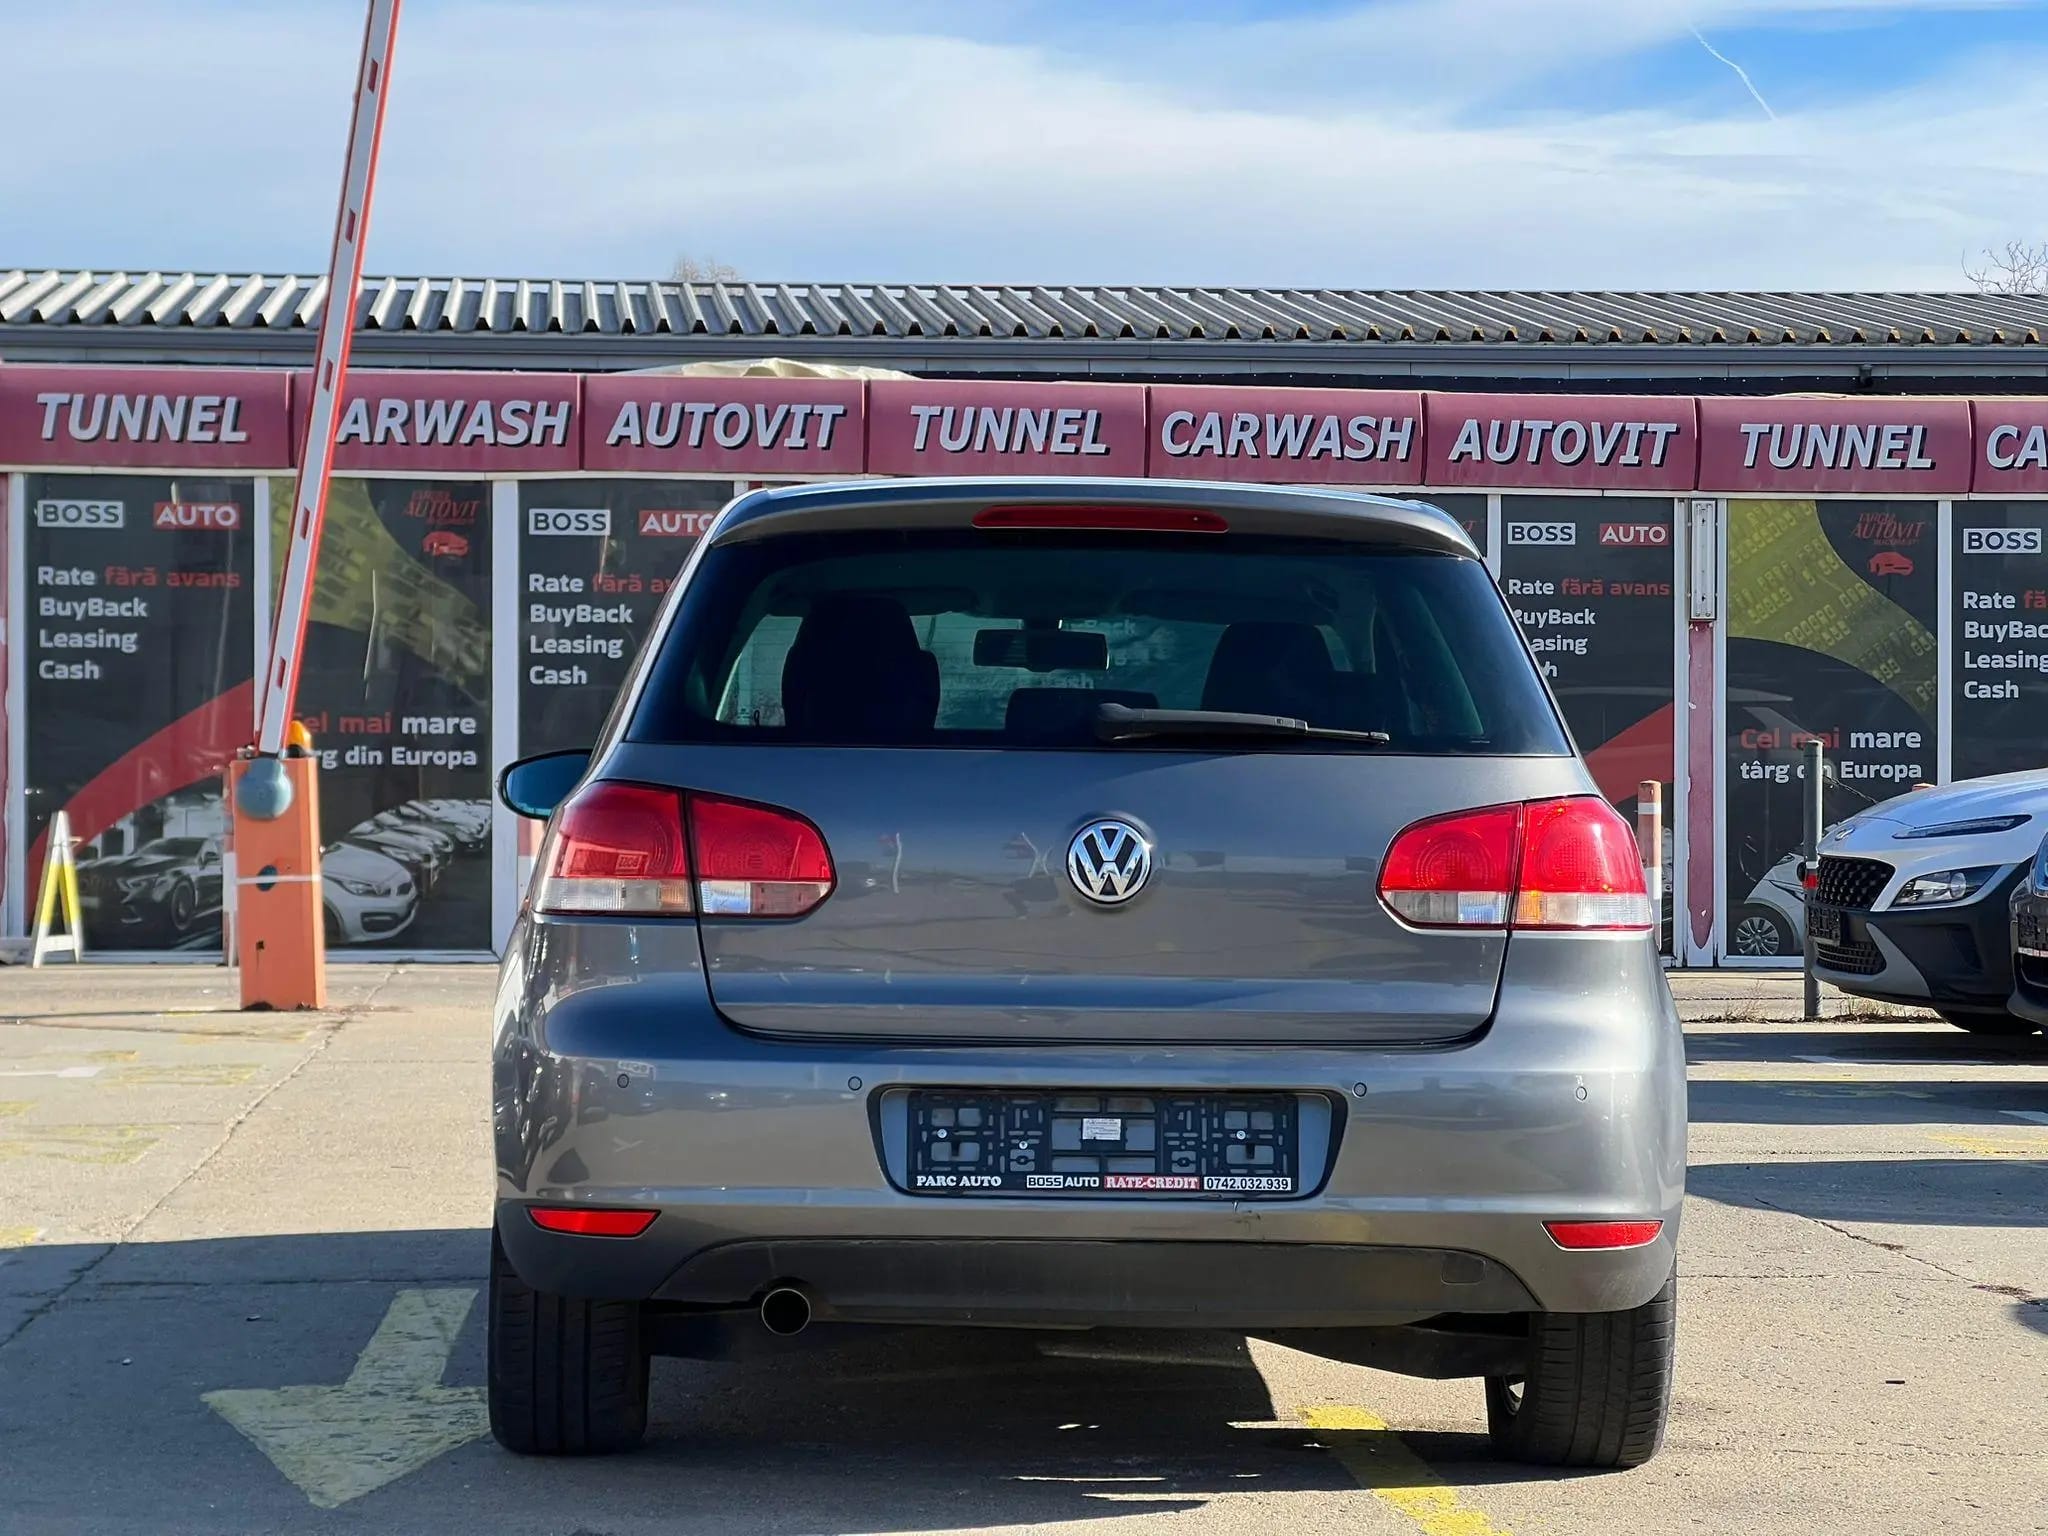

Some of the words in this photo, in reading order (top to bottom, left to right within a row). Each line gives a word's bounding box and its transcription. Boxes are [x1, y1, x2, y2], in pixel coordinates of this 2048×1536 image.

[37, 393, 249, 443] TUNNEL
[335, 398, 571, 446] ARWASH
[606, 401, 846, 449] AUTOVIT
[910, 405, 1109, 454] TUNNEL
[1161, 410, 1415, 460] CARWASH
[1448, 419, 1679, 467] AUTOVIT
[1739, 423, 1935, 469] TUNNEL
[1986, 424, 2048, 470] CA
[42, 504, 120, 523] BOSS
[156, 505, 238, 527] AUTO
[533, 512, 607, 531] BOSS
[1511, 525, 1573, 542] BOSS
[1601, 526, 1666, 543] AUTO
[1967, 531, 2038, 550] BOSS
[37, 566, 96, 586] Rate
[166, 572, 240, 587] avans
[528, 573, 584, 593] Rate
[1508, 578, 1555, 595] Rate
[1609, 583, 1670, 595] avans
[39, 597, 149, 621] BuyBack
[1963, 591, 2016, 609] Rate
[2024, 590, 2048, 609] fă
[530, 603, 633, 627] BuyBack
[39, 628, 139, 653] Leasing
[1964, 620, 2048, 643] BuyBac
[529, 634, 624, 659] Leasing
[1530, 634, 1588, 655] asing
[38, 660, 101, 680] Cash
[529, 664, 588, 685] Cash
[1964, 680, 2019, 699] Cash
[339, 711, 392, 734] mai
[401, 716, 477, 735] mare
[1740, 727, 1780, 749] Cel
[1850, 731, 1921, 749] mare
[344, 745, 384, 766] din
[391, 746, 477, 770] Europa
[1740, 761, 1790, 784] târg
[1840, 761, 1922, 783] Europa
[916, 1175, 957, 1187] PARC
[958, 1175, 1002, 1187] AUTO
[1028, 1176, 1063, 1187] BOSS
[1064, 1176, 1100, 1188] AUTO
[1206, 1177, 1290, 1190] 0742.032.939
